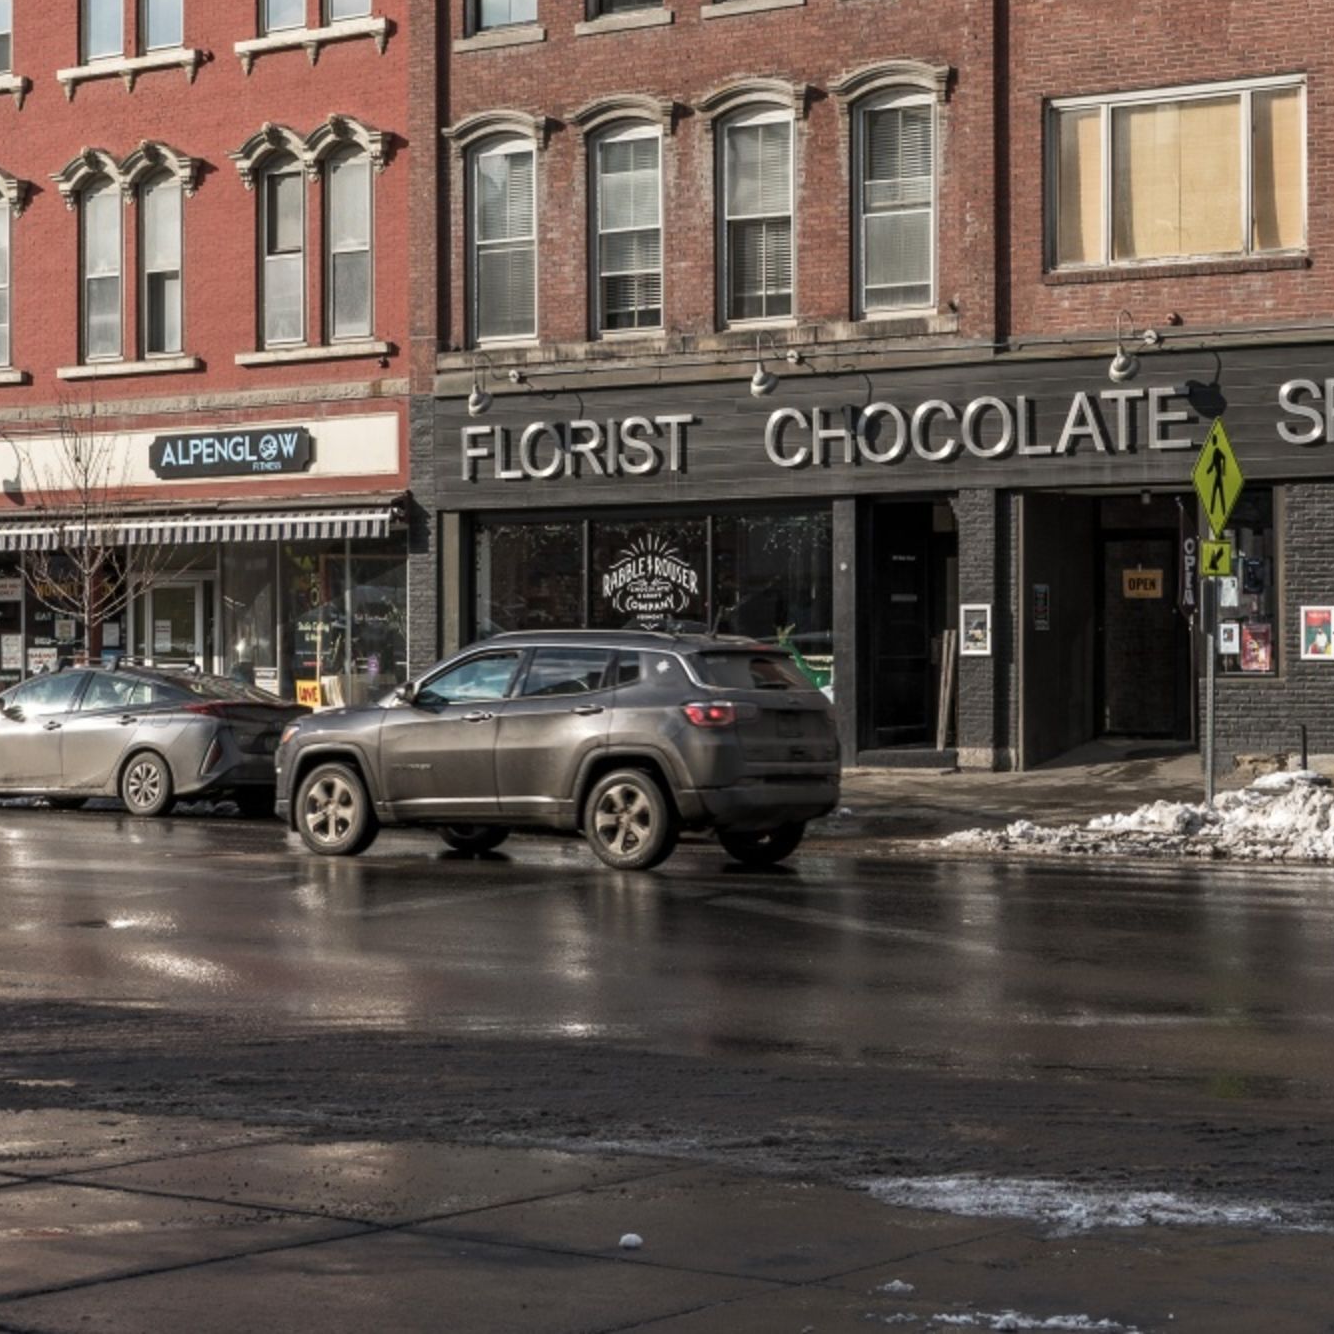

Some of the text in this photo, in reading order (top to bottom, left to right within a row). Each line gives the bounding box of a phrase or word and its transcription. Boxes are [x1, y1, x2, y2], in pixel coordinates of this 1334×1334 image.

[161, 432, 299, 467] ALPENGLOW
[460, 414, 693, 481] FLORIST
[764, 385, 1193, 467] CHOCOLATE
[602, 556, 699, 597] RABBLE ROUSER
[1128, 577, 1156, 592] OPEN
[625, 593, 674, 611] COMPANY
